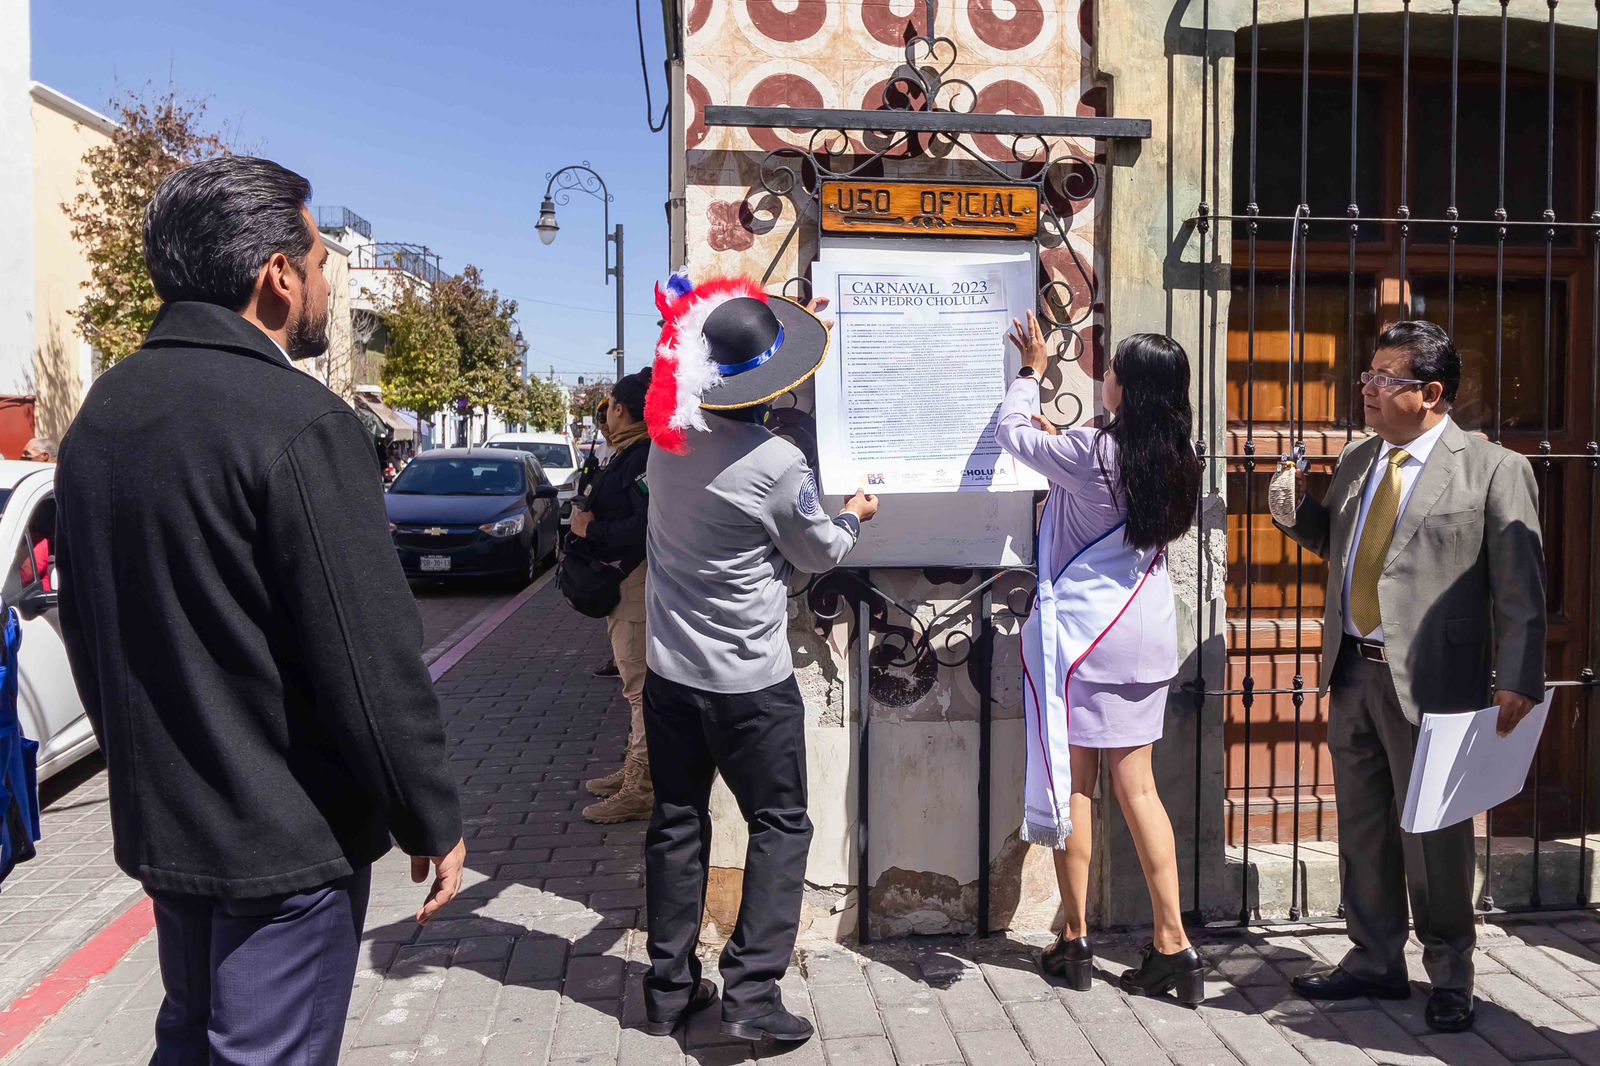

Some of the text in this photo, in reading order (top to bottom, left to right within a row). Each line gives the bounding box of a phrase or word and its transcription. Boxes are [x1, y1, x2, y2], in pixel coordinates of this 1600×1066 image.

[837, 188, 1023, 219] USO OFICIAL
[852, 280, 988, 295] CARNAVAL 2023
[852, 295, 990, 307] SAN PEDRO CHOLULA
